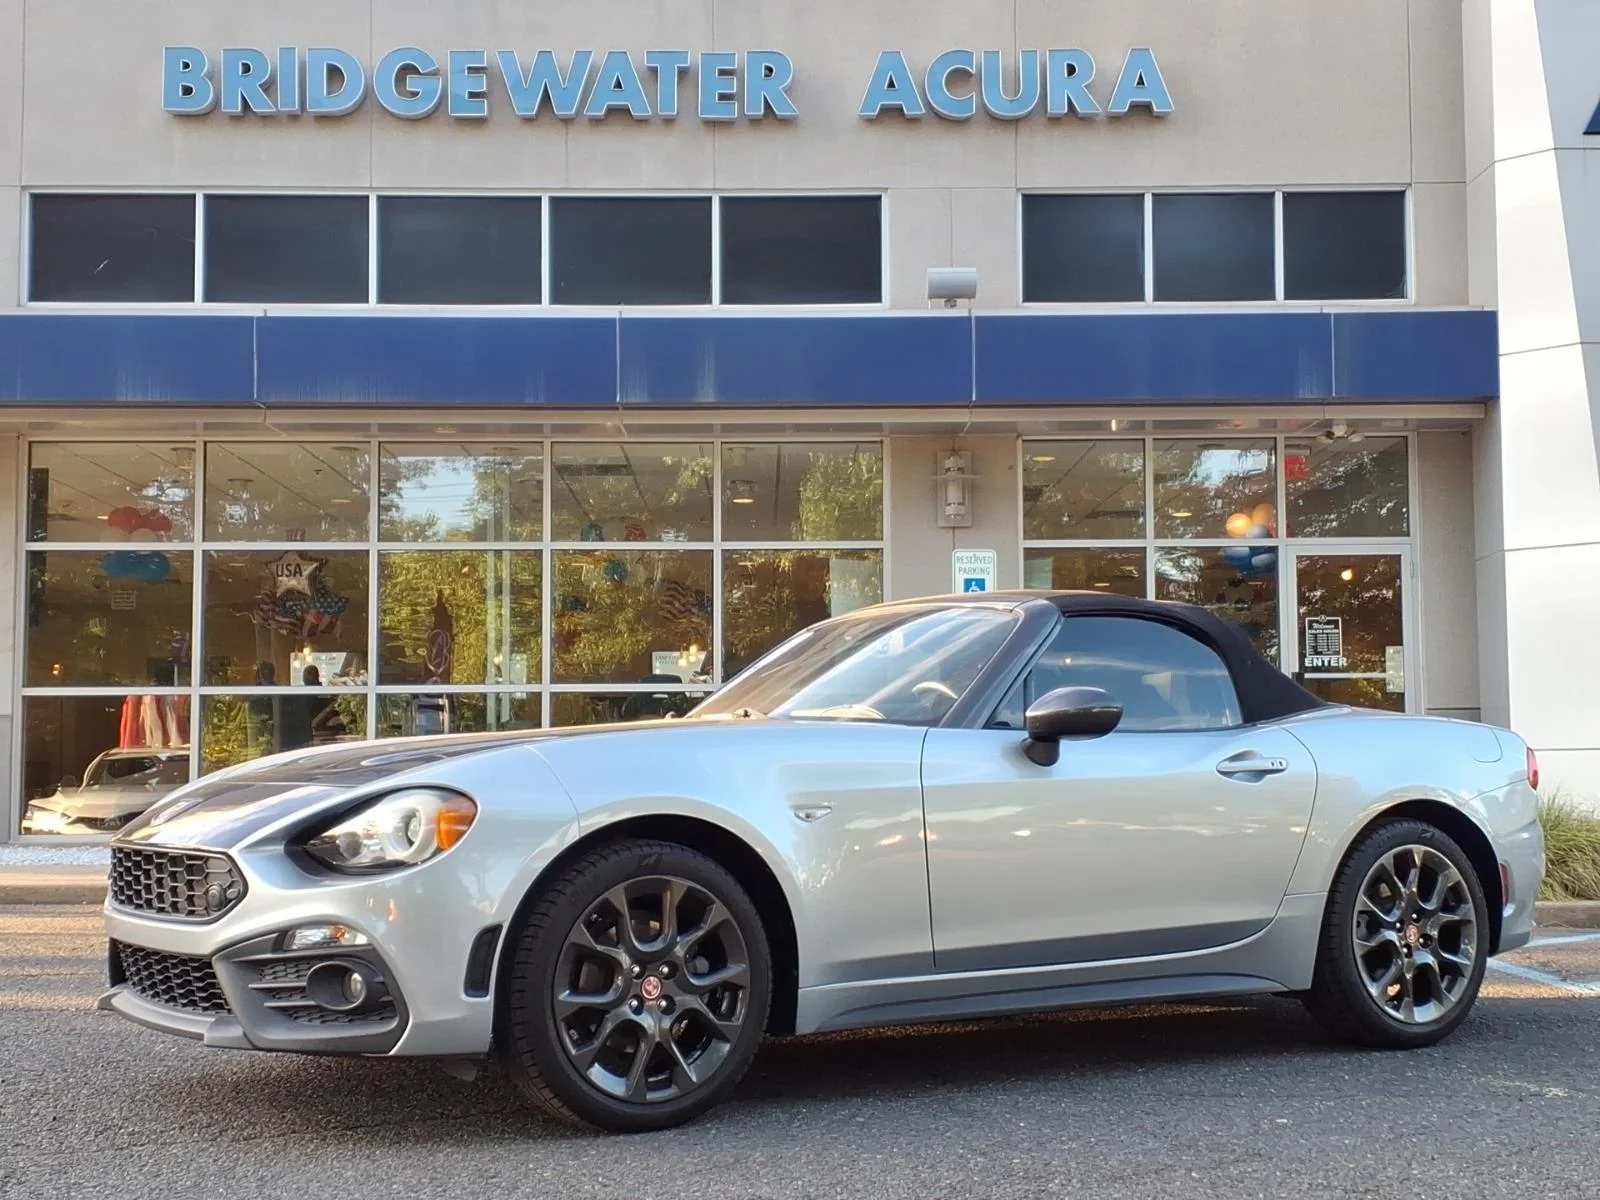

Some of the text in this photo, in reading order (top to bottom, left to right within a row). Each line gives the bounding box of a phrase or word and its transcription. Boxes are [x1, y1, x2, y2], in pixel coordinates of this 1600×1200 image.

[162, 46, 1176, 121] BRIDGEWATER ACURA
[956, 555, 993, 564] RESERVED
[275, 563, 303, 577] USA
[958, 567, 991, 575] PARKING
[1304, 657, 1348, 668] ENTER
